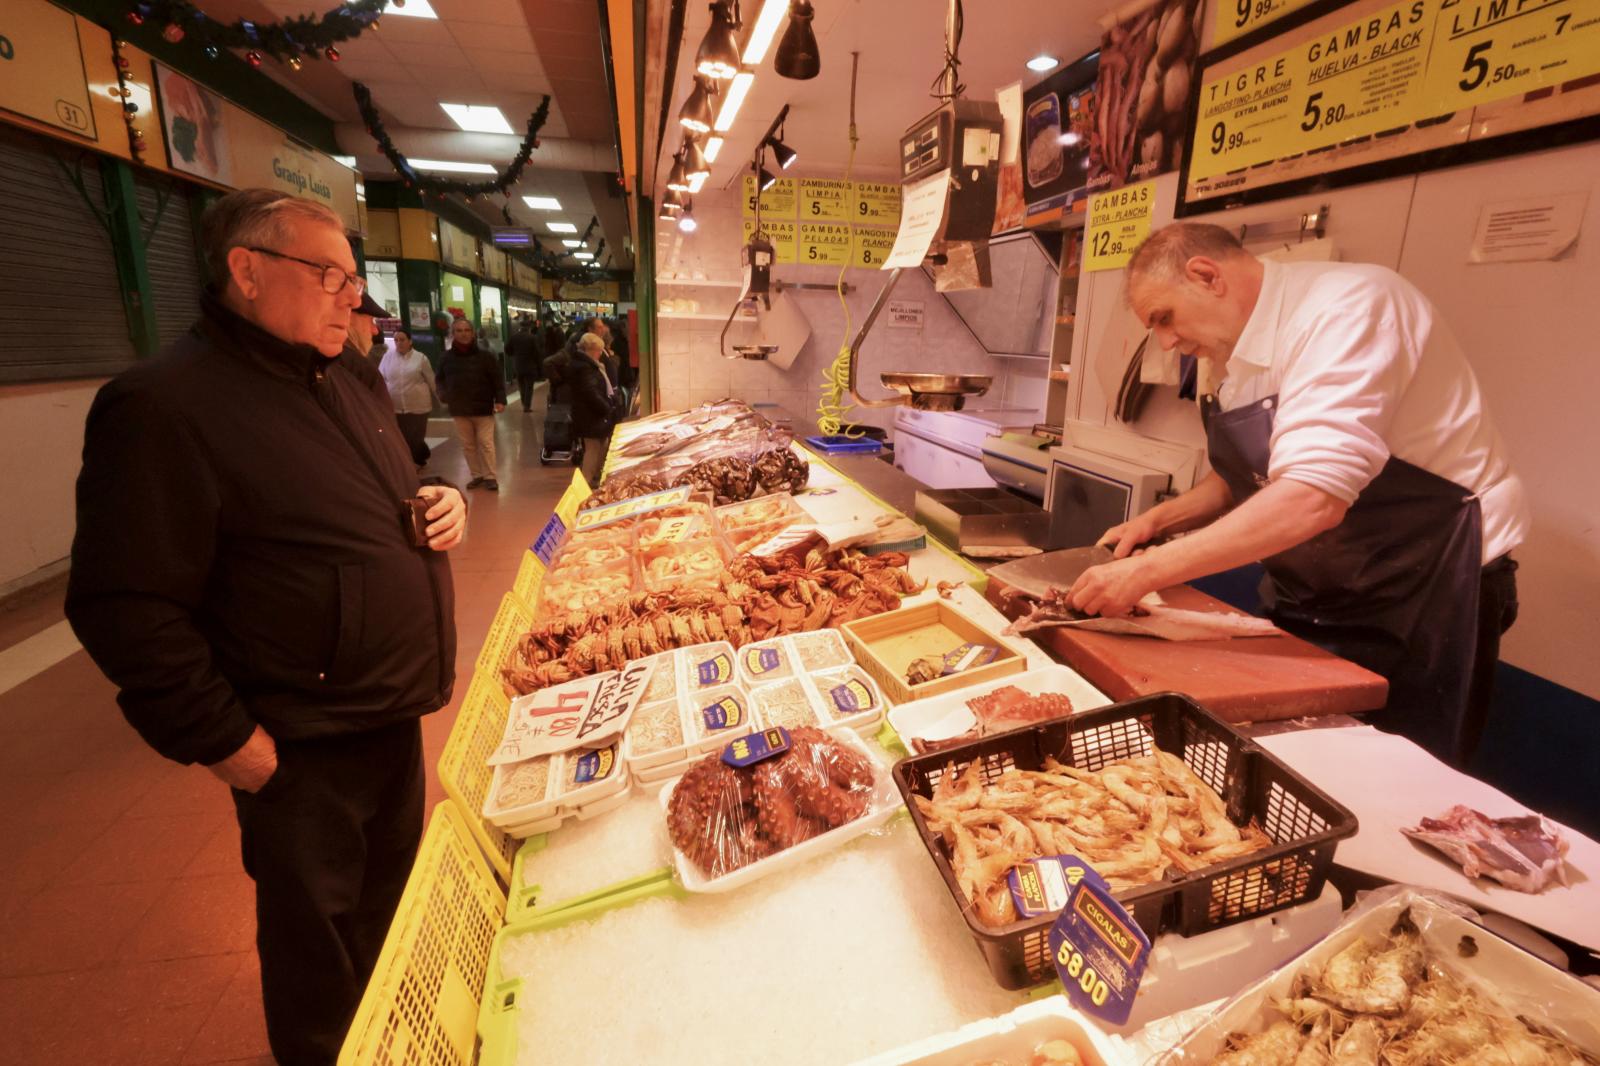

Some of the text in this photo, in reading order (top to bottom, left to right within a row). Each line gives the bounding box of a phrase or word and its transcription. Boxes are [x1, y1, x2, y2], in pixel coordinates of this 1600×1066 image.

[1451, 0, 1548, 35] LIMP
[1555, 13, 1571, 36] 7
[1308, 1, 1424, 63] GAMBAS
[1308, 54, 1359, 81] HUELVA
[1370, 29, 1423, 60] BLACK
[1459, 40, 1515, 92] 5,50
[1210, 58, 1286, 101] TIGRE
[1253, 78, 1292, 100] PLANCHA
[63, 106, 79, 123] 31
[1234, 95, 1288, 118] EXTRA BUENO
[1301, 91, 1345, 131] 5,80
[1211, 121, 1243, 155] 9,99
[272, 158, 331, 199] Granja Luisa
[1095, 187, 1148, 212] GAMBAS
[1116, 206, 1148, 220] PLANCHA
[744, 222, 794, 232] GMBAS
[801, 224, 849, 234] GAMBAS
[804, 235, 849, 244] PELADAS
[854, 228, 899, 238] LANGOSTIN
[863, 239, 894, 249] PLANCH
[579, 491, 682, 526] OFERTA
[1086, 903, 1129, 949] CIGALAS
